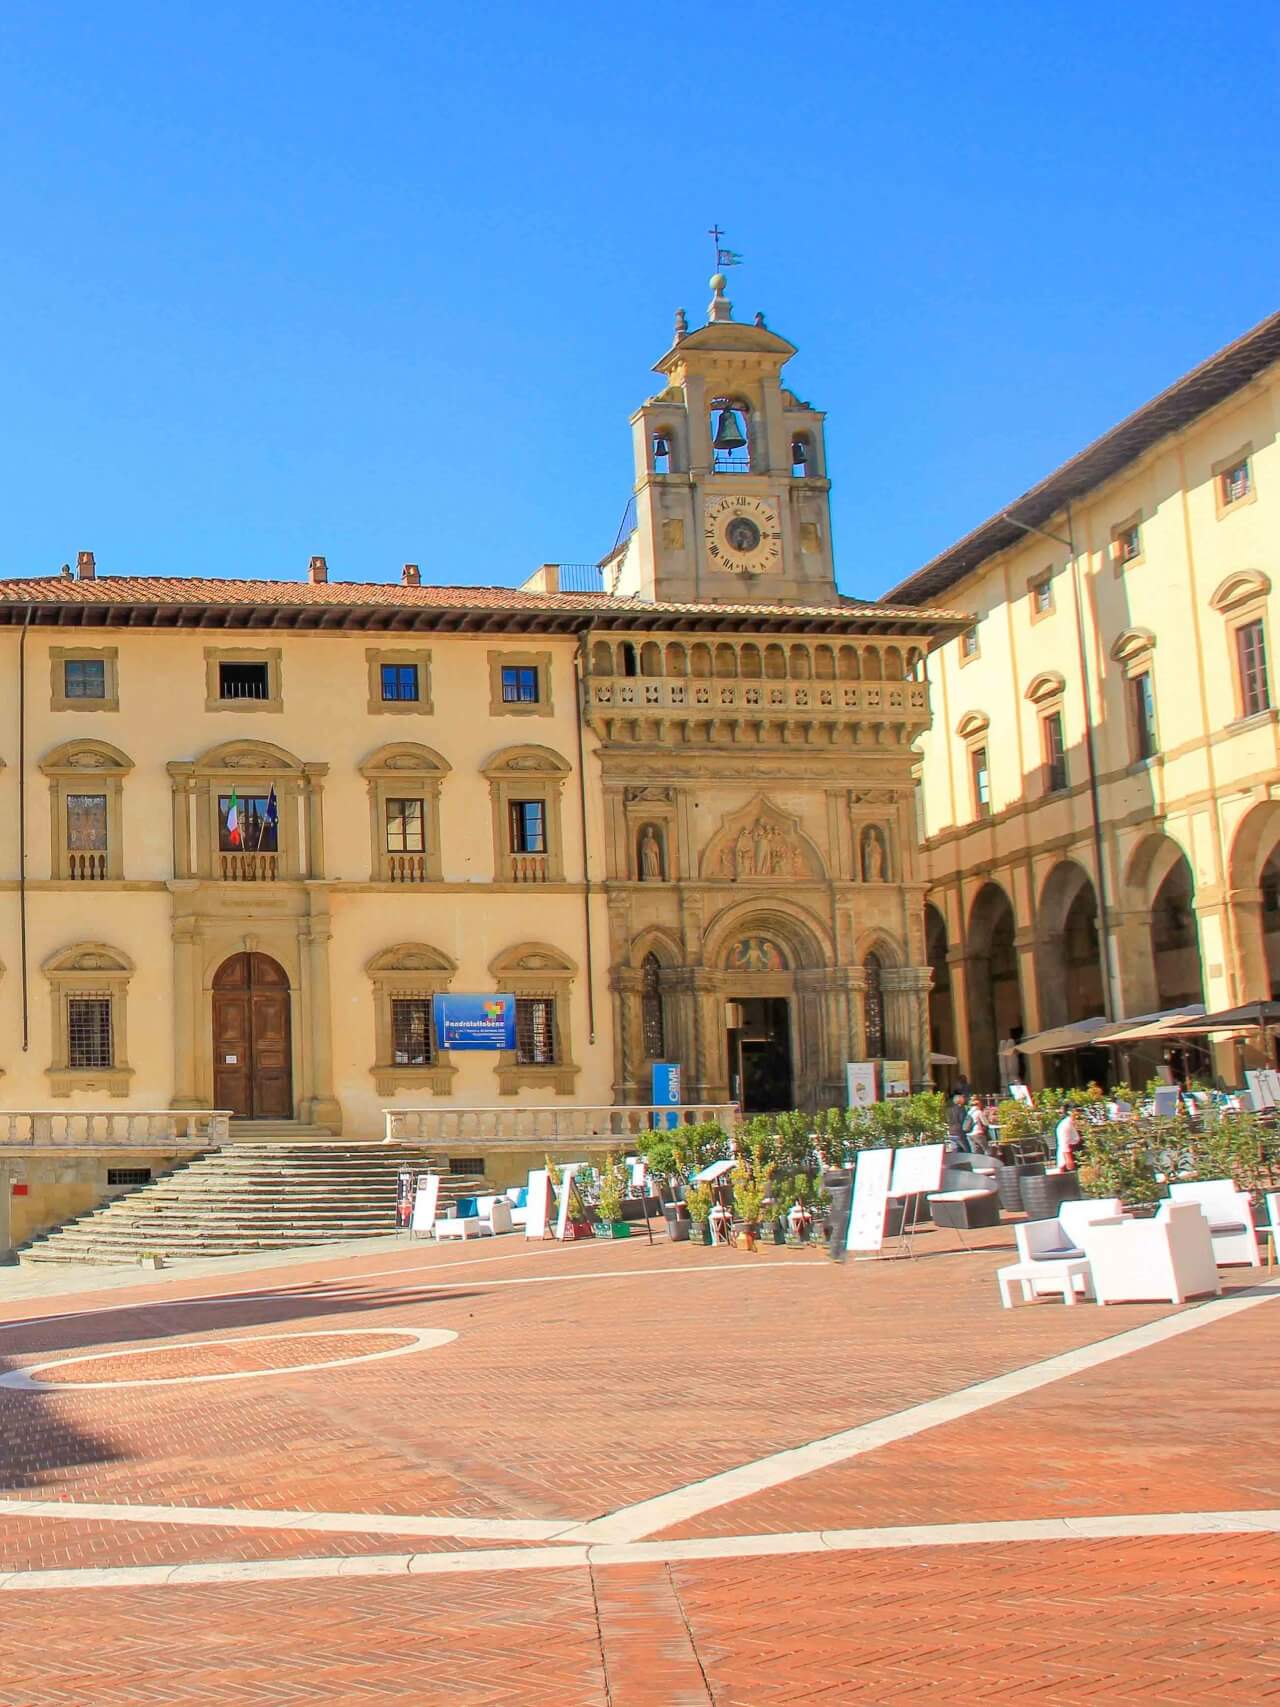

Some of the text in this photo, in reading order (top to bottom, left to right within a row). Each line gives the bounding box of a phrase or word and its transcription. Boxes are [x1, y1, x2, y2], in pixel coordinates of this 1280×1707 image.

[721, 500, 730, 511] XI
[736, 497, 746, 506] XII
[765, 513, 775, 522] II
[704, 529, 715, 538] IX
[771, 532, 782, 540] III
[709, 544, 720, 558] VIII
[723, 558, 734, 571] VII
